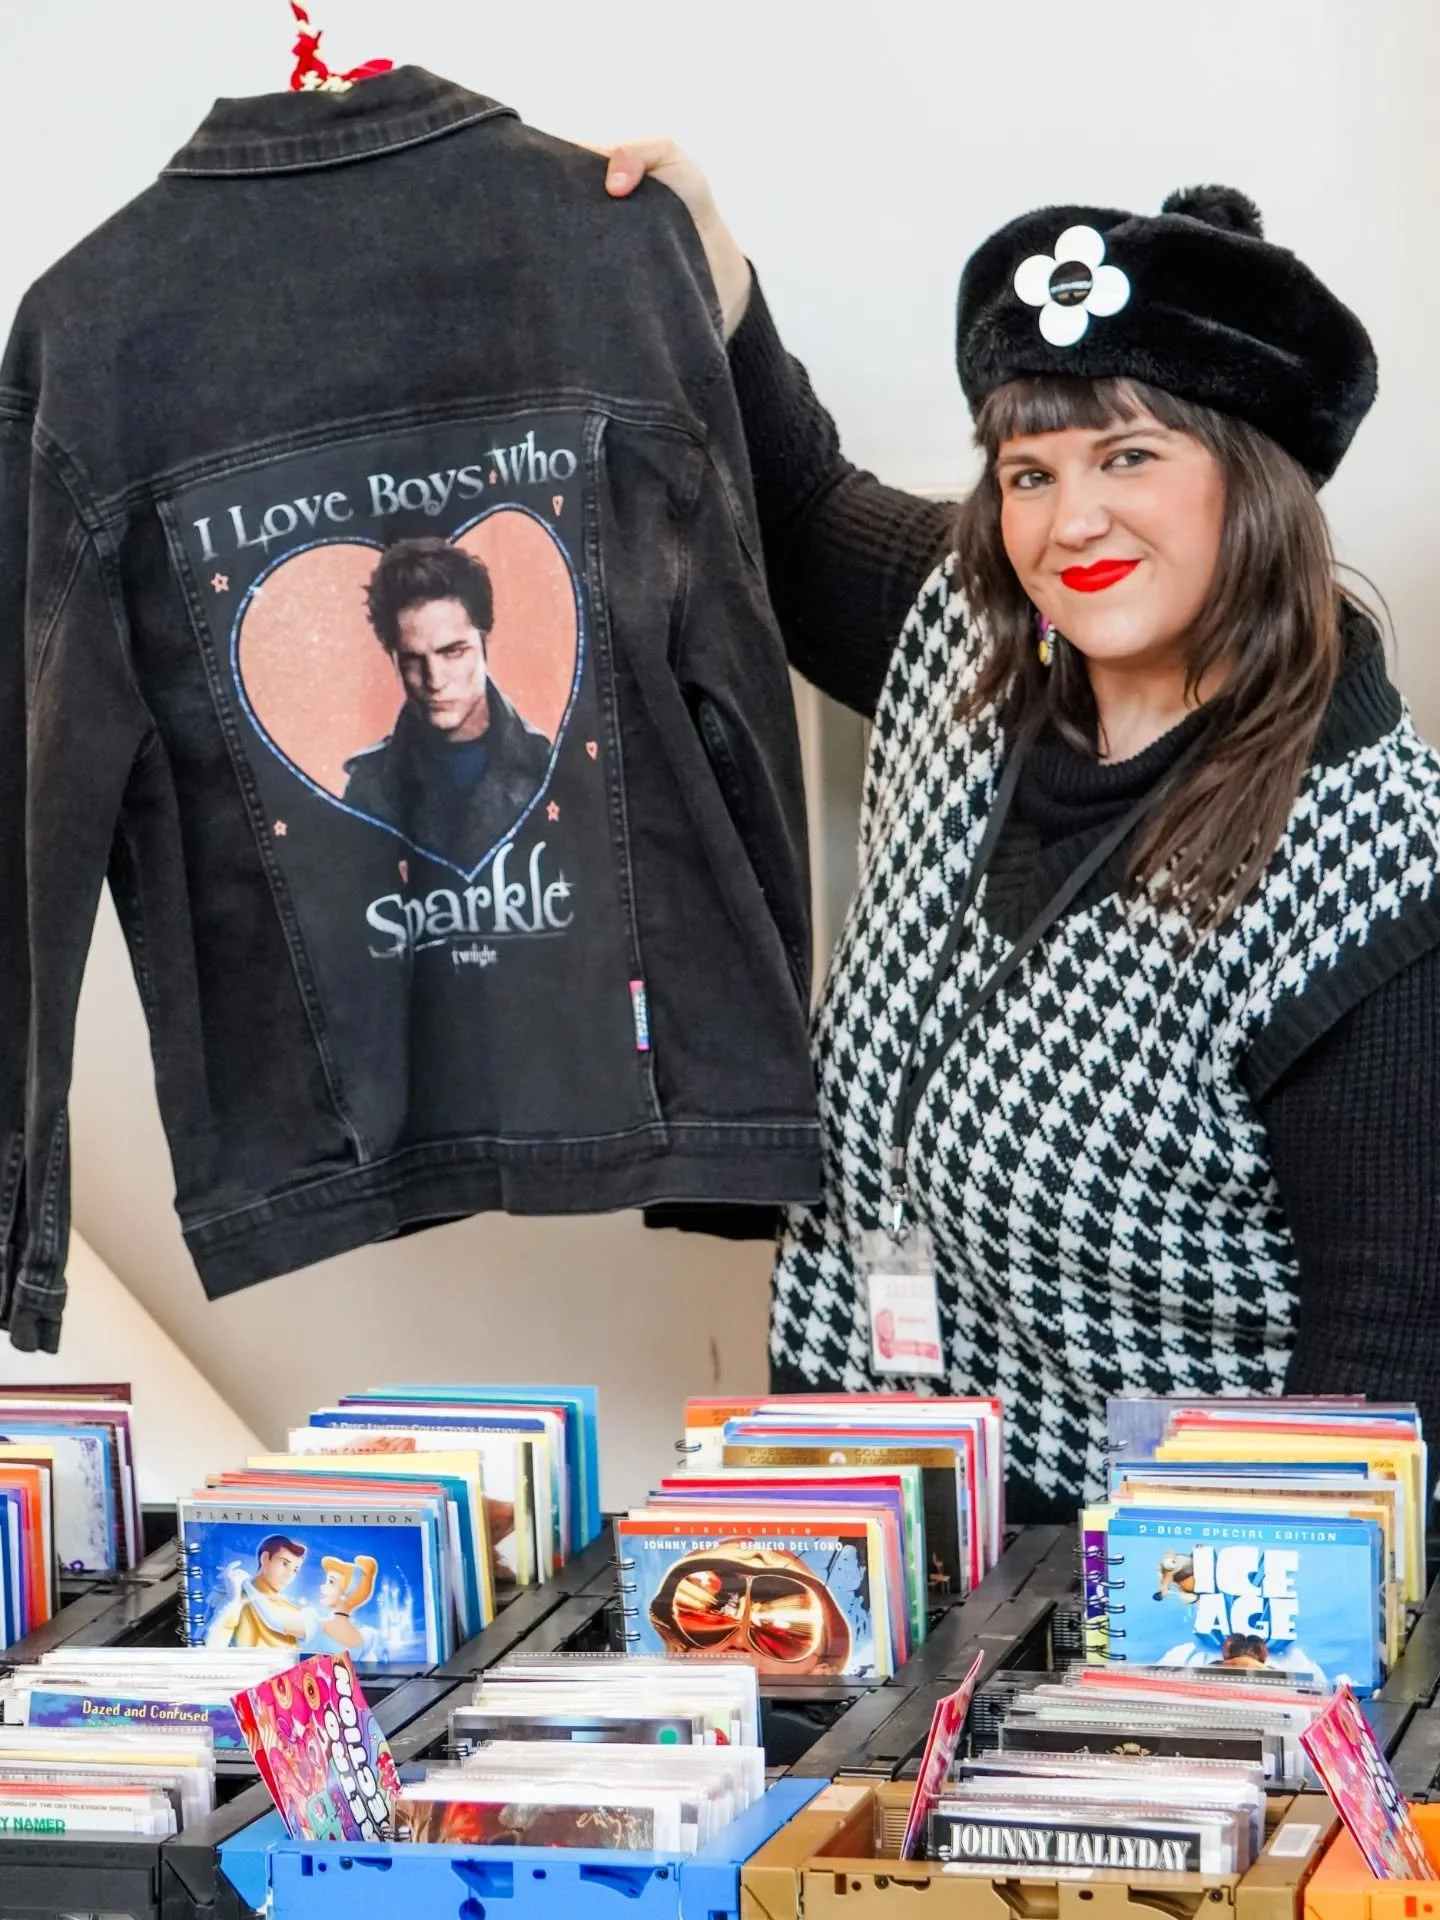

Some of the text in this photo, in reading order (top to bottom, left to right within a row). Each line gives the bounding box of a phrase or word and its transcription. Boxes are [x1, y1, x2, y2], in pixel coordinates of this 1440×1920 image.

[193, 431, 577, 561] I Love Boys Who
[366, 841, 574, 959] Sparkle
[196, 1511, 413, 1525] PLATINUM EDITION
[673, 1526, 812, 1535] WIDESCREEN
[1139, 1525, 1337, 1541] 2-DISC SPECIAL EDITION
[643, 1541, 844, 1552] JOHNNY DEPP BENICIO DEL TORO
[1192, 1544, 1300, 1599] ICE
[1193, 1593, 1299, 1641] AGE
[82, 1700, 209, 1722] Dazed and Confused
[13, 1816, 66, 1833] NAMED
[950, 1823, 1192, 1871] JOHNNY HALLYDAY
